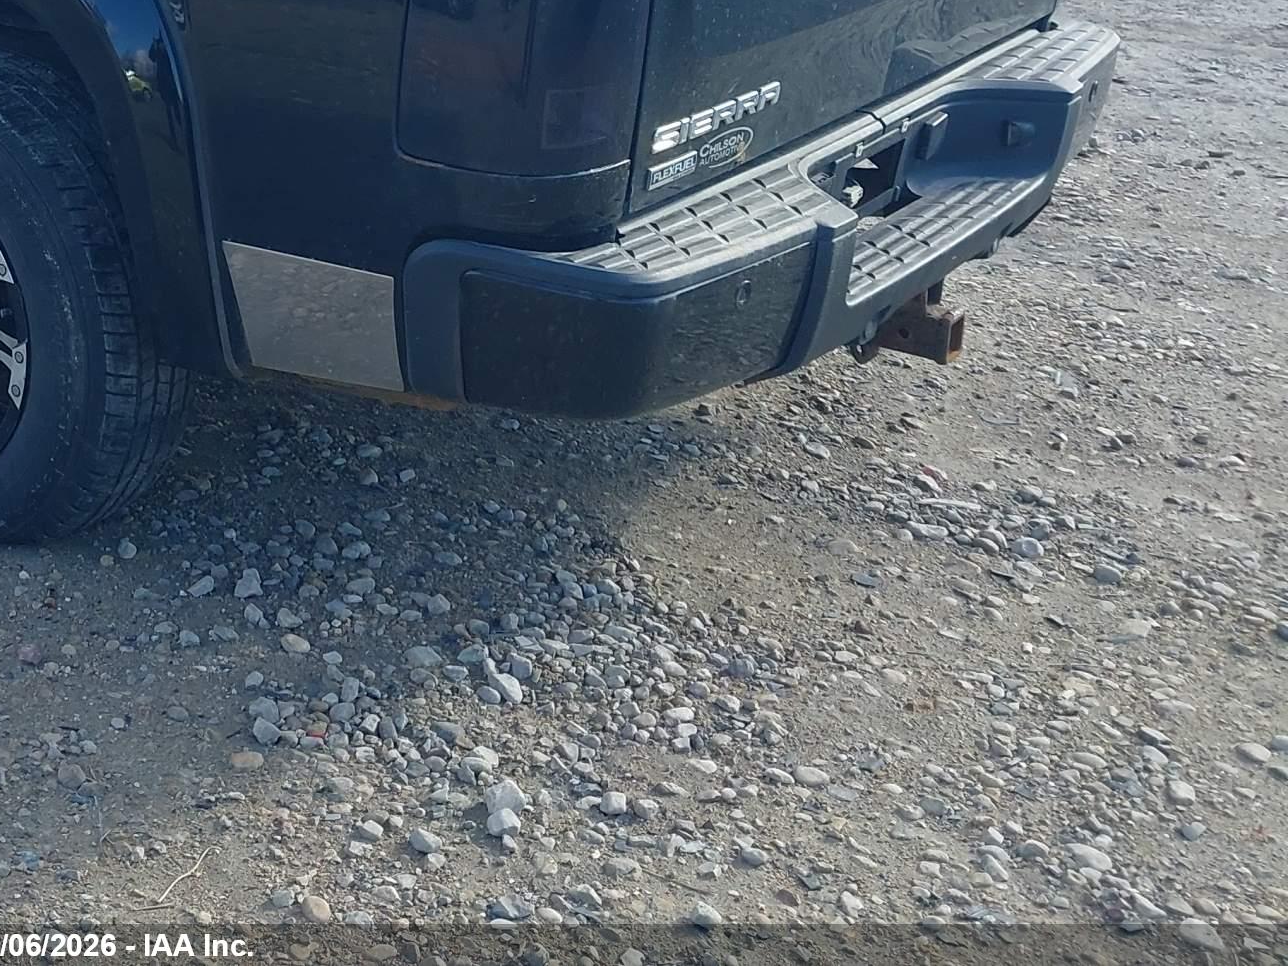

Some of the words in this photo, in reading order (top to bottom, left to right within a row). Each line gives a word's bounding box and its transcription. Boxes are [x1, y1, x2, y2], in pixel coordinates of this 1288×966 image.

[651, 81, 781, 154] SIERRA
[699, 132, 745, 158] CHILSON
[653, 156, 696, 184] FLEXFUEL
